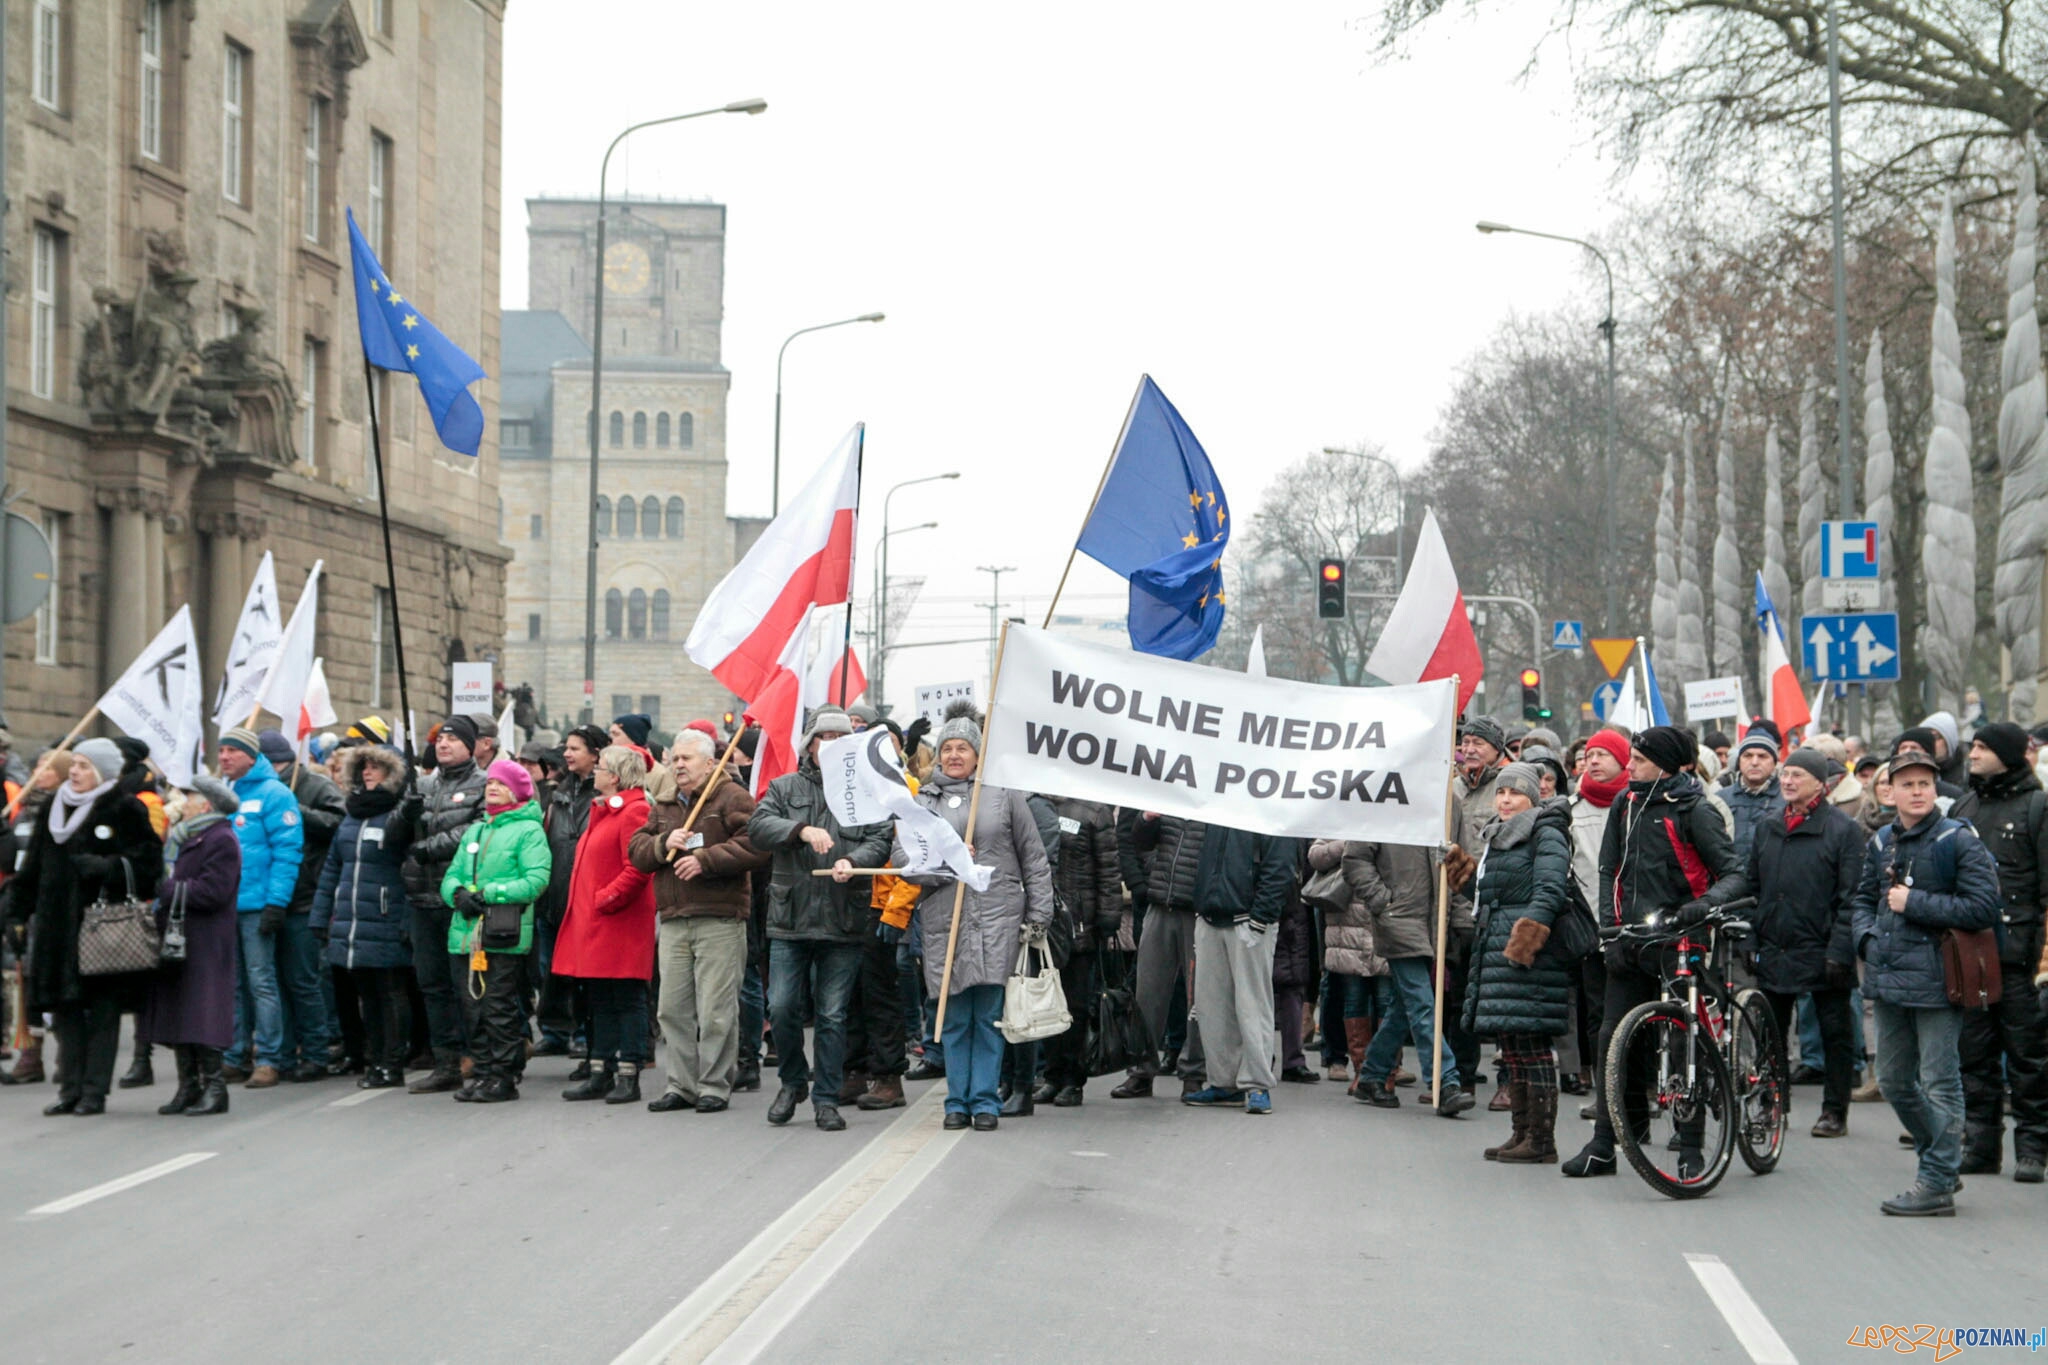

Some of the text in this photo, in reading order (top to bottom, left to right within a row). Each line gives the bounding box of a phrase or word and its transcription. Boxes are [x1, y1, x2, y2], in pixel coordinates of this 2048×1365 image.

[921, 687, 971, 701] WOLNE
[1052, 670, 1386, 751] WOLNE MEDIA
[1026, 721, 1410, 805] WOLNA POLSKA
